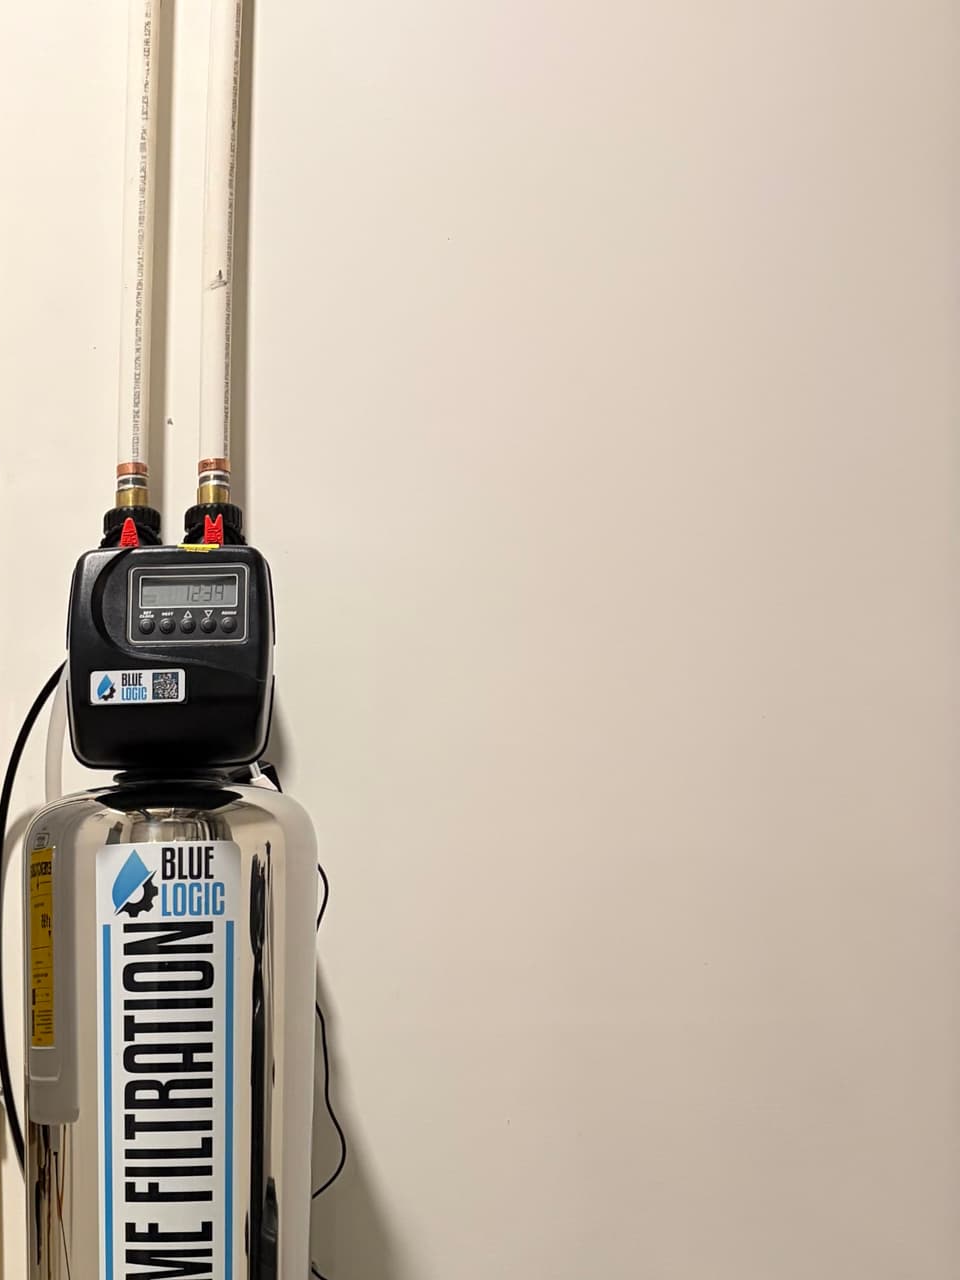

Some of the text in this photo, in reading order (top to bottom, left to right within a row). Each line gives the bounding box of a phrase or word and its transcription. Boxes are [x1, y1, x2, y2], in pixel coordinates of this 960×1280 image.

[121, 673, 143, 687] BLUE
[121, 687, 147, 701] LOGIC
[161, 847, 214, 880] BLUE
[161, 882, 225, 916] LOGIC
[122, 920, 214, 1202] FILTRATION
